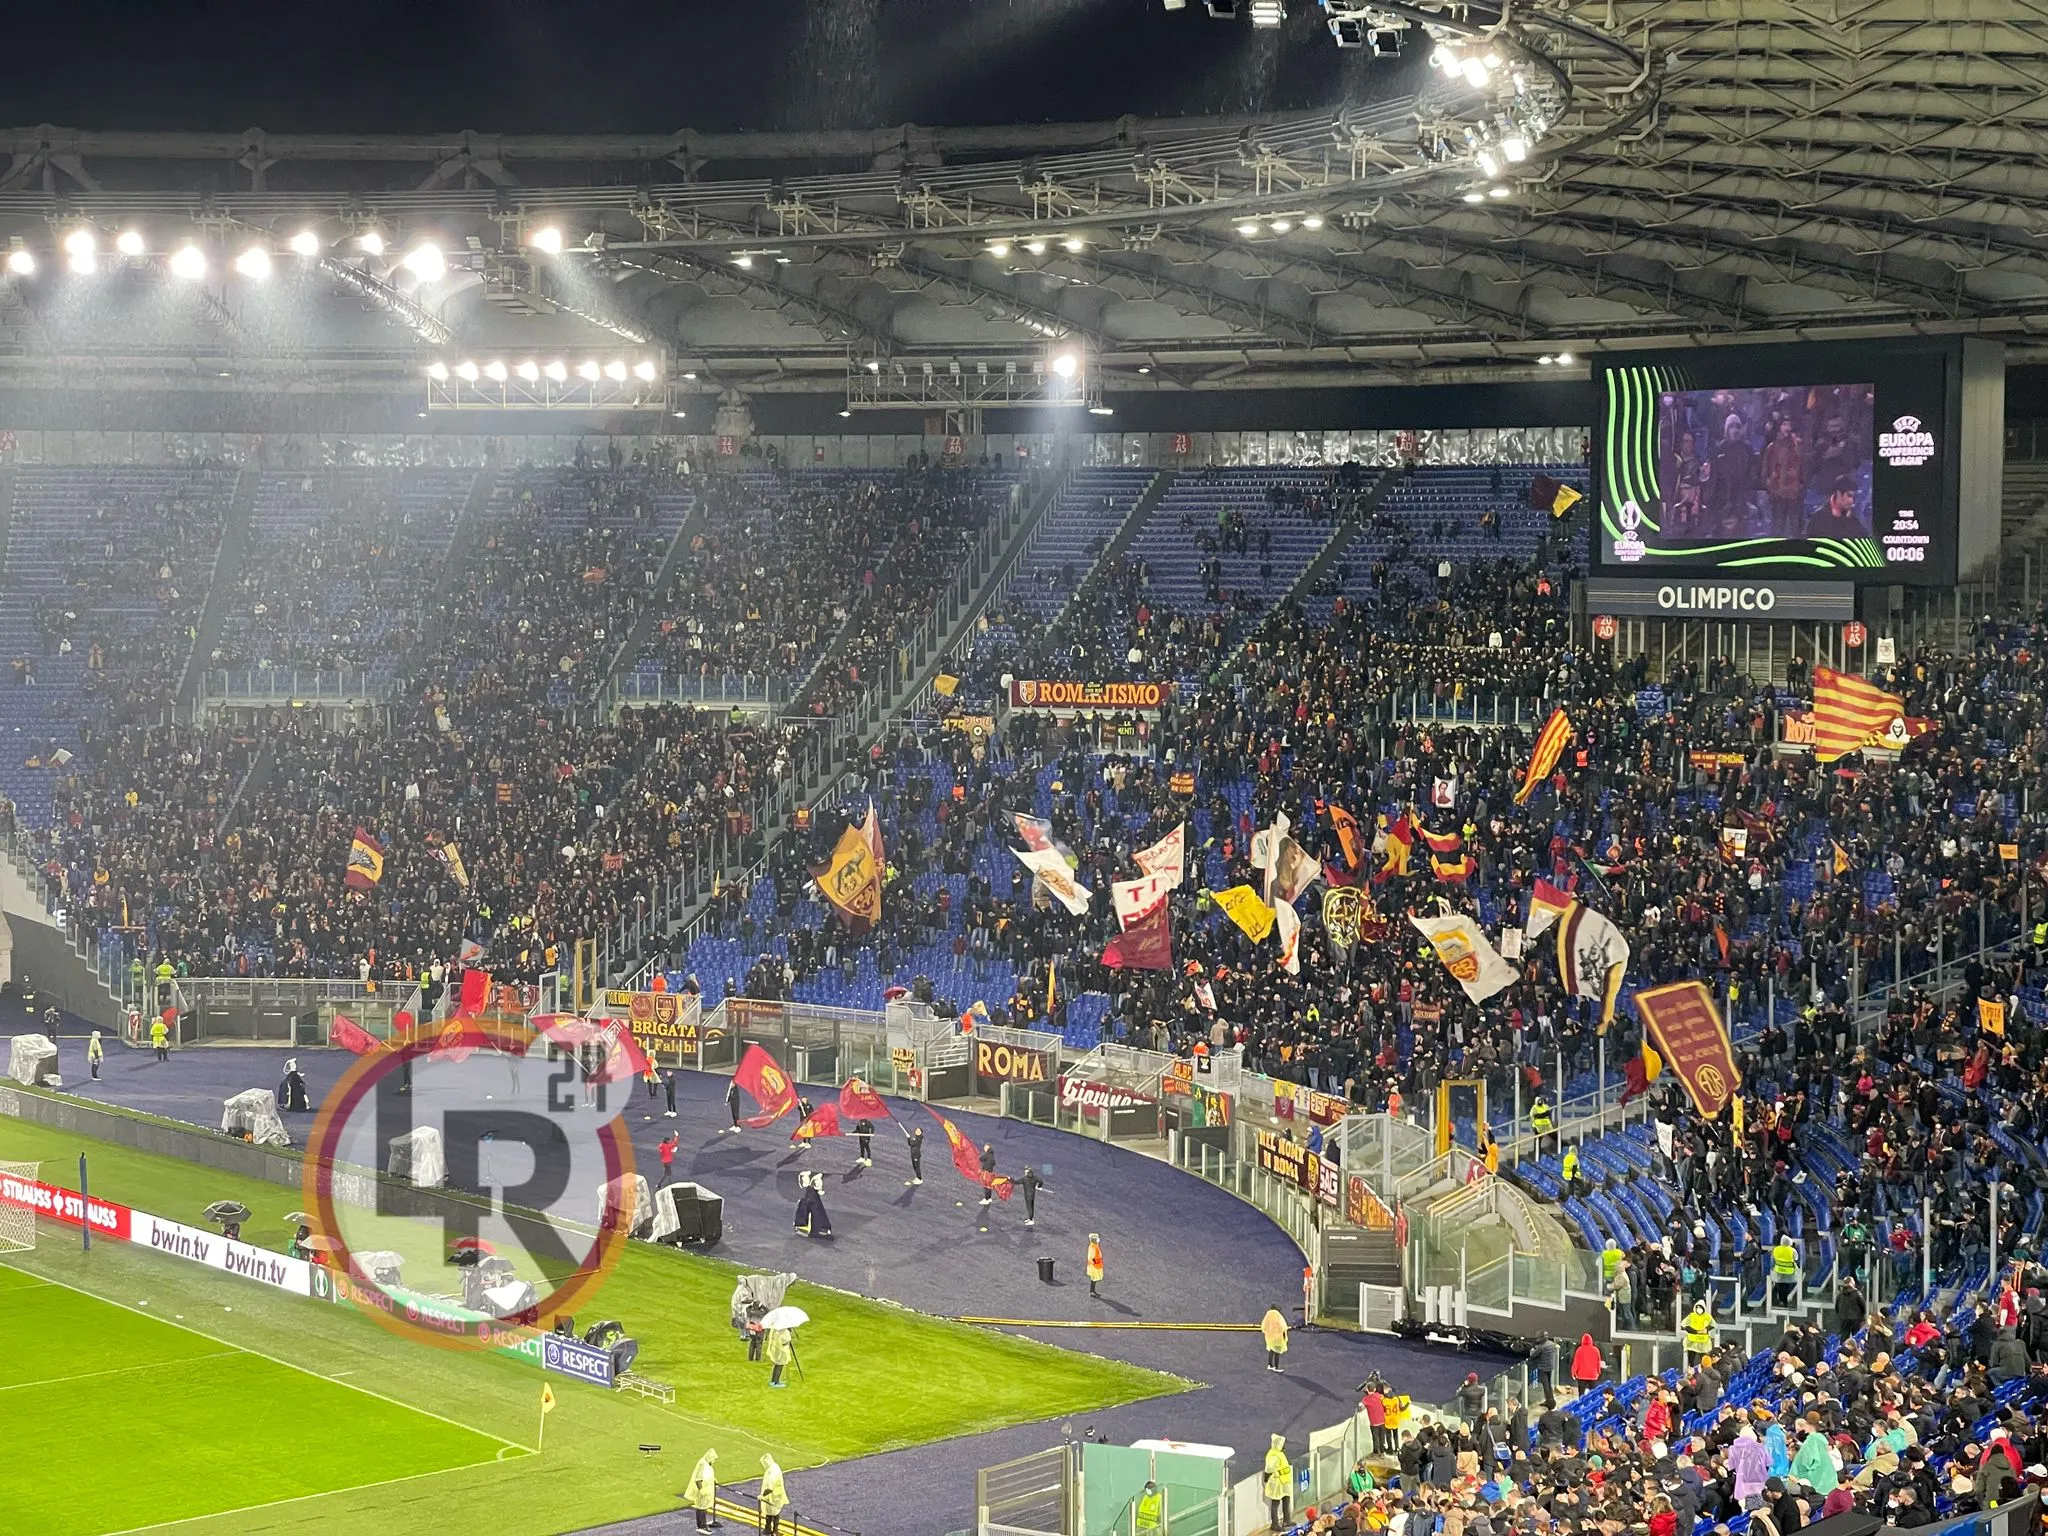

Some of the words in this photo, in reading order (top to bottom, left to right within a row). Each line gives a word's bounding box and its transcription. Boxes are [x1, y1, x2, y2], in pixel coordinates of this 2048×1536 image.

[721, 437, 732, 446] 22
[1176, 434, 1186, 443] 21
[1879, 432, 1934, 447] EUROPA
[1176, 443, 1187, 453] AS
[1879, 447, 1934, 457] CONFERENCE
[1883, 536, 1930, 544] COUNTDOWN
[1887, 547, 1925, 561] 00:06
[1658, 586, 1775, 611] OLIMPICO
[1600, 615, 1612, 625] 20
[1599, 625, 1613, 637] AD
[1849, 621, 1860, 633] 19
[1849, 632, 1861, 645] AS
[632, 1020, 697, 1038] BRIGATA
[978, 1043, 1044, 1081] ROMA
[3, 1179, 51, 1209] STRAUSS
[152, 1220, 209, 1261] bwin.tv
[225, 1243, 287, 1285] bwin.tv
[351, 1285, 394, 1313] RESPECT
[421, 1305, 465, 1334] RESPECT
[493, 1328, 542, 1359] RESPECT
[562, 1347, 610, 1379] RESPECT
